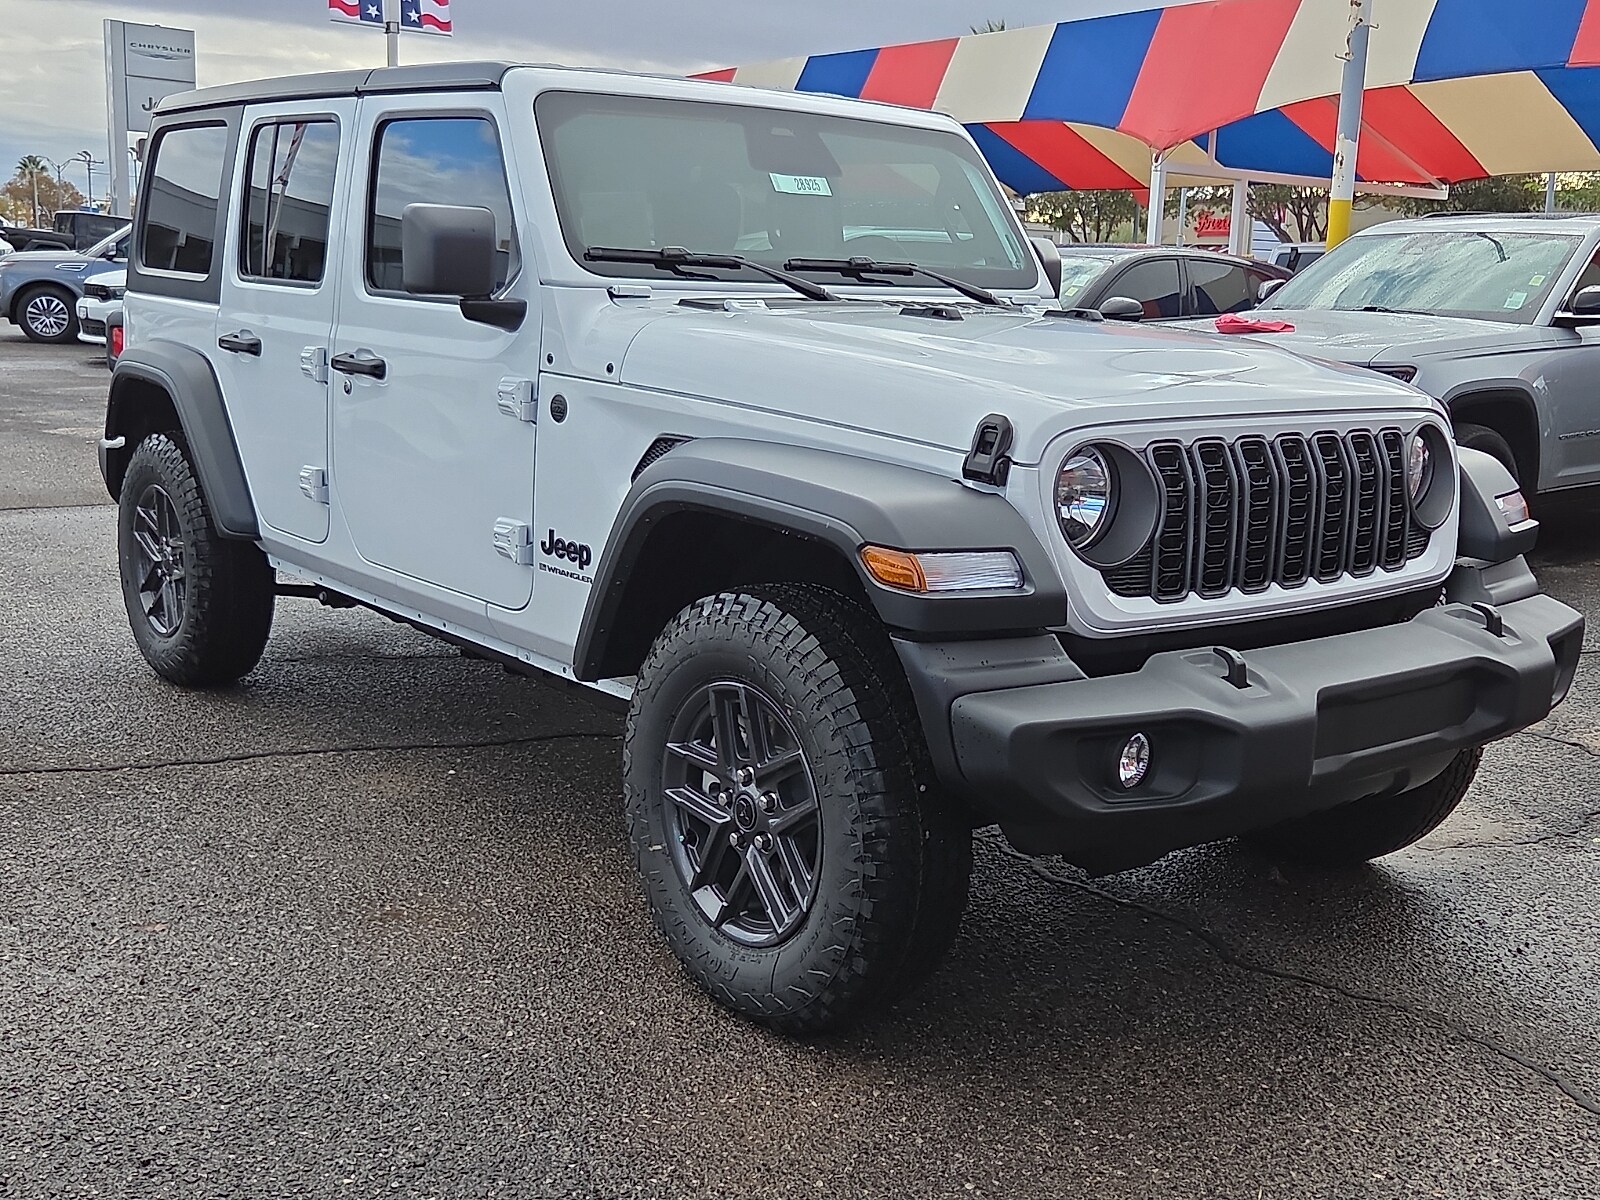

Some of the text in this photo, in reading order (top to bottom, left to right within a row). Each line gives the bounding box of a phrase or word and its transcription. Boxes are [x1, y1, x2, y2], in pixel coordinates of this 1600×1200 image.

[130, 42, 191, 53] CHRYSLER
[793, 178, 821, 191] 28925
[540, 528, 592, 570] Jeep
[547, 564, 593, 584] WRANGLER
